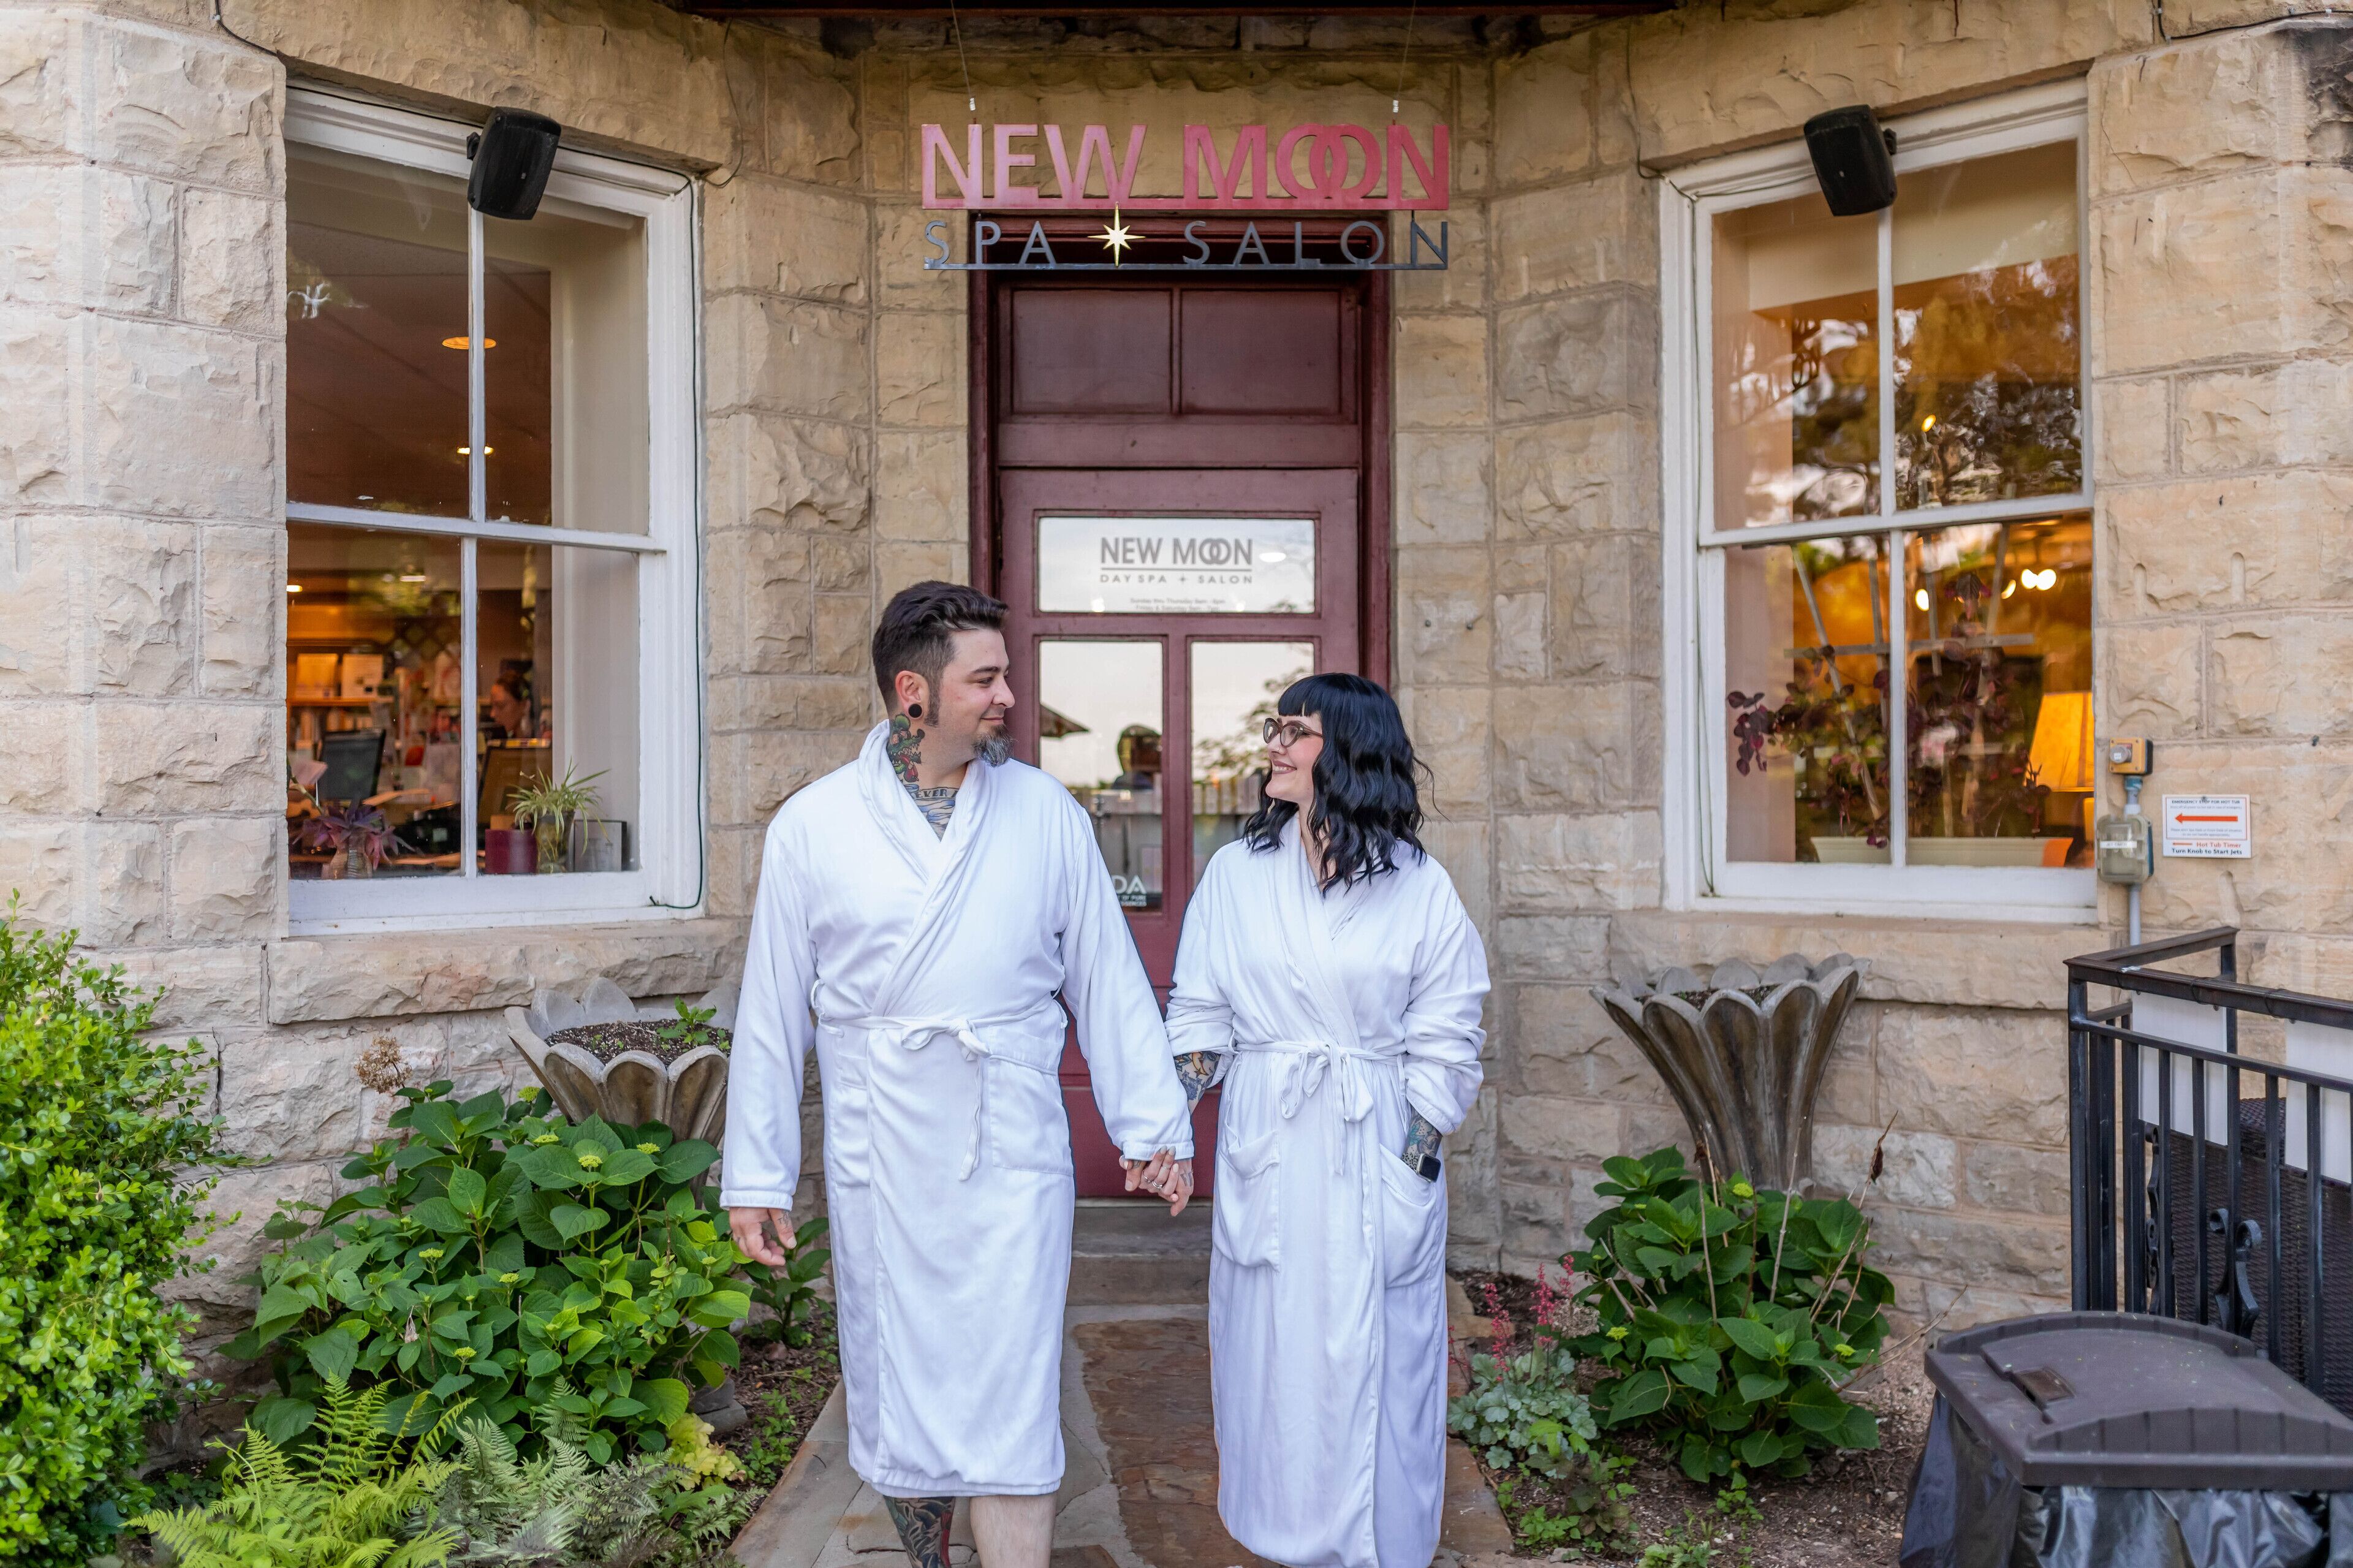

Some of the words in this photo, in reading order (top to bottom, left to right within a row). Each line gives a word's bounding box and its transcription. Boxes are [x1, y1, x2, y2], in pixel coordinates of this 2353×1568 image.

[921, 124, 1148, 209] NEW
[1183, 123, 1449, 210] MOON
[923, 220, 1056, 270] SPA
[1183, 221, 1448, 270] SALON
[1101, 537, 1163, 564] NEW
[1173, 537, 1252, 564] MOON
[1100, 574, 1131, 583] DAY
[1138, 574, 1167, 583] SPA
[1197, 575, 1252, 584] SALON
